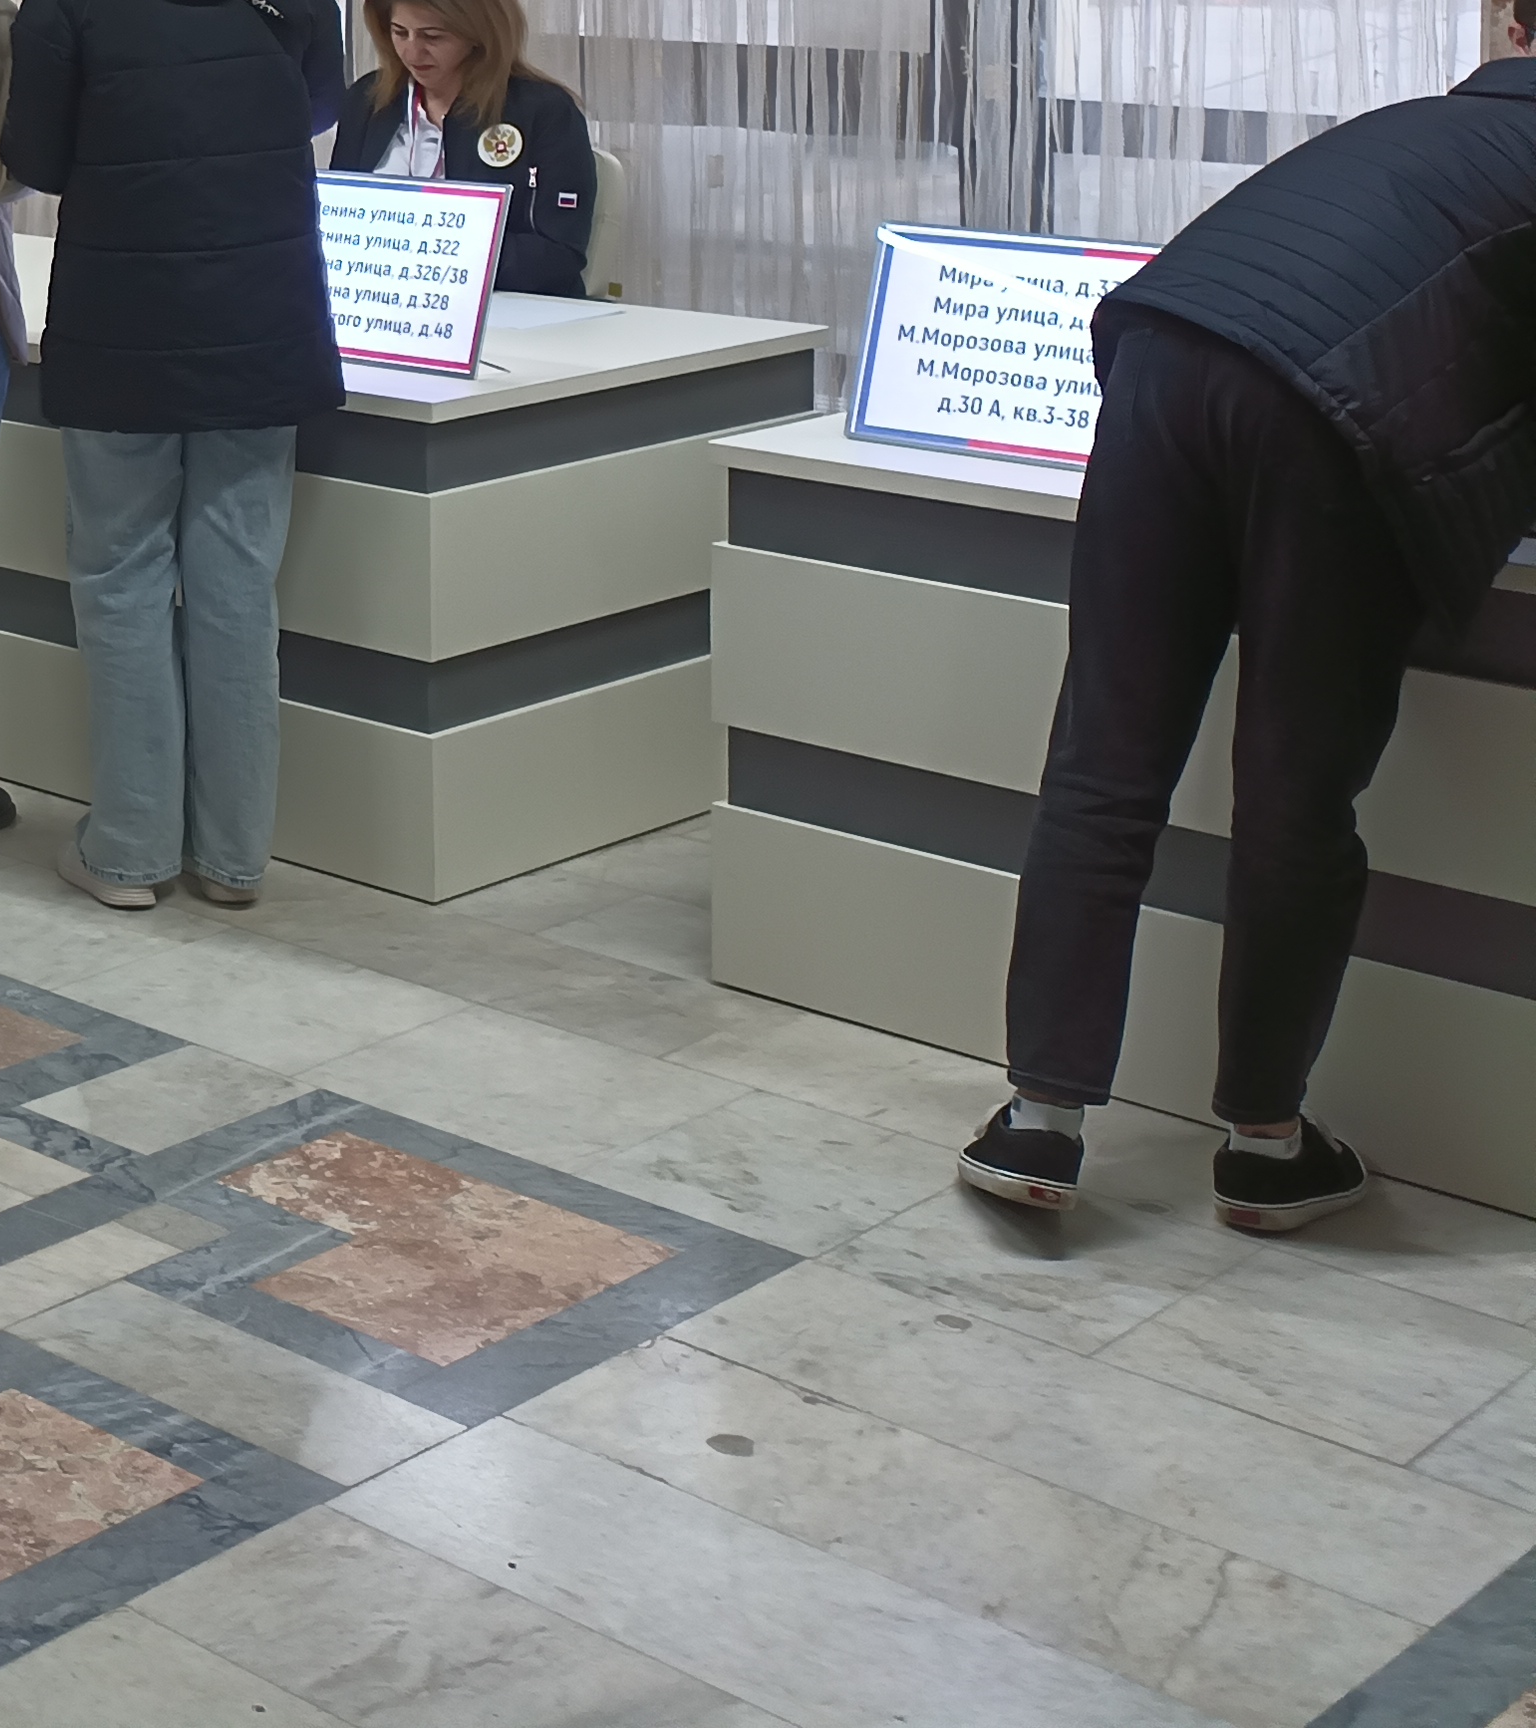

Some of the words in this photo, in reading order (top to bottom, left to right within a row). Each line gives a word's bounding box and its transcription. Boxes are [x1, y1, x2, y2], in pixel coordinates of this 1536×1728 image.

[321, 203, 366, 220] енина
[422, 211, 466, 229] д.320
[417, 238, 460, 256] д.322
[398, 264, 469, 285] д.326/38
[407, 292, 449, 311] д.328
[934, 296, 989, 321] Мира
[995, 306, 1063, 329] улица,
[418, 322, 453, 339] д.48
[898, 325, 1026, 355] М.Морозова
[917, 358, 1047, 391] М.Морозова
[937, 395, 982, 415] д.30
[988, 399, 1005, 421] А,
[1013, 405, 1089, 429] кв.3-38
